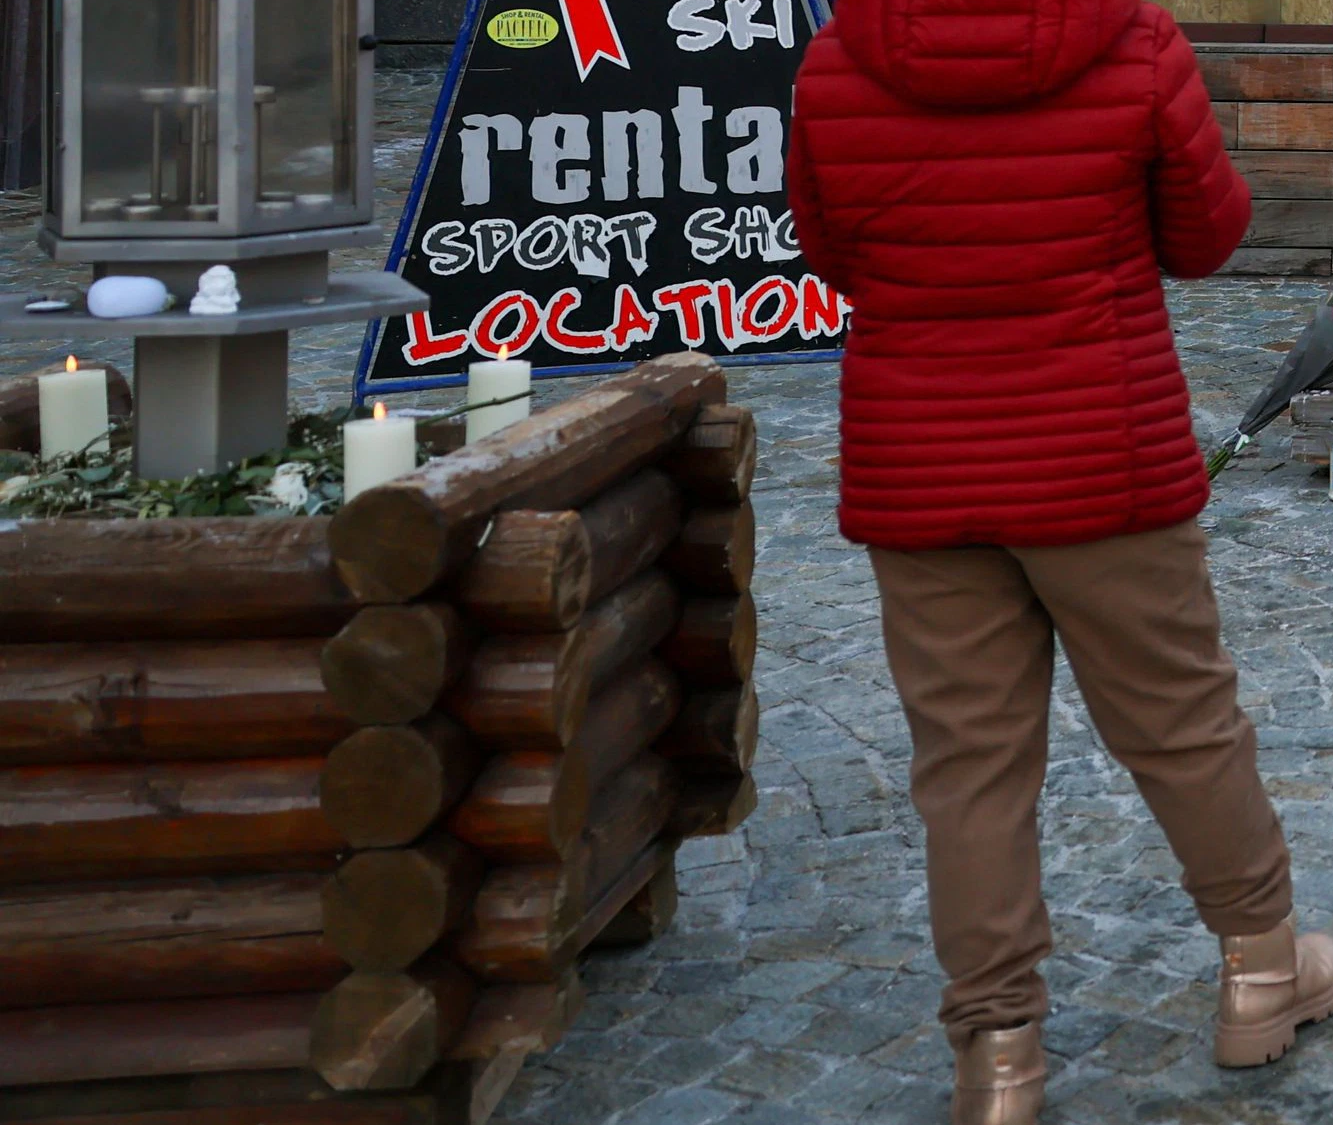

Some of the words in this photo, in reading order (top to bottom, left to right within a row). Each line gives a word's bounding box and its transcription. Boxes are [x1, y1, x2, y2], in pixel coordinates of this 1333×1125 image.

[496, 19, 550, 37] PACIFIC
[458, 85, 796, 206] renta
[421, 211, 657, 278] SPORT
[402, 274, 855, 366] LOCATION
